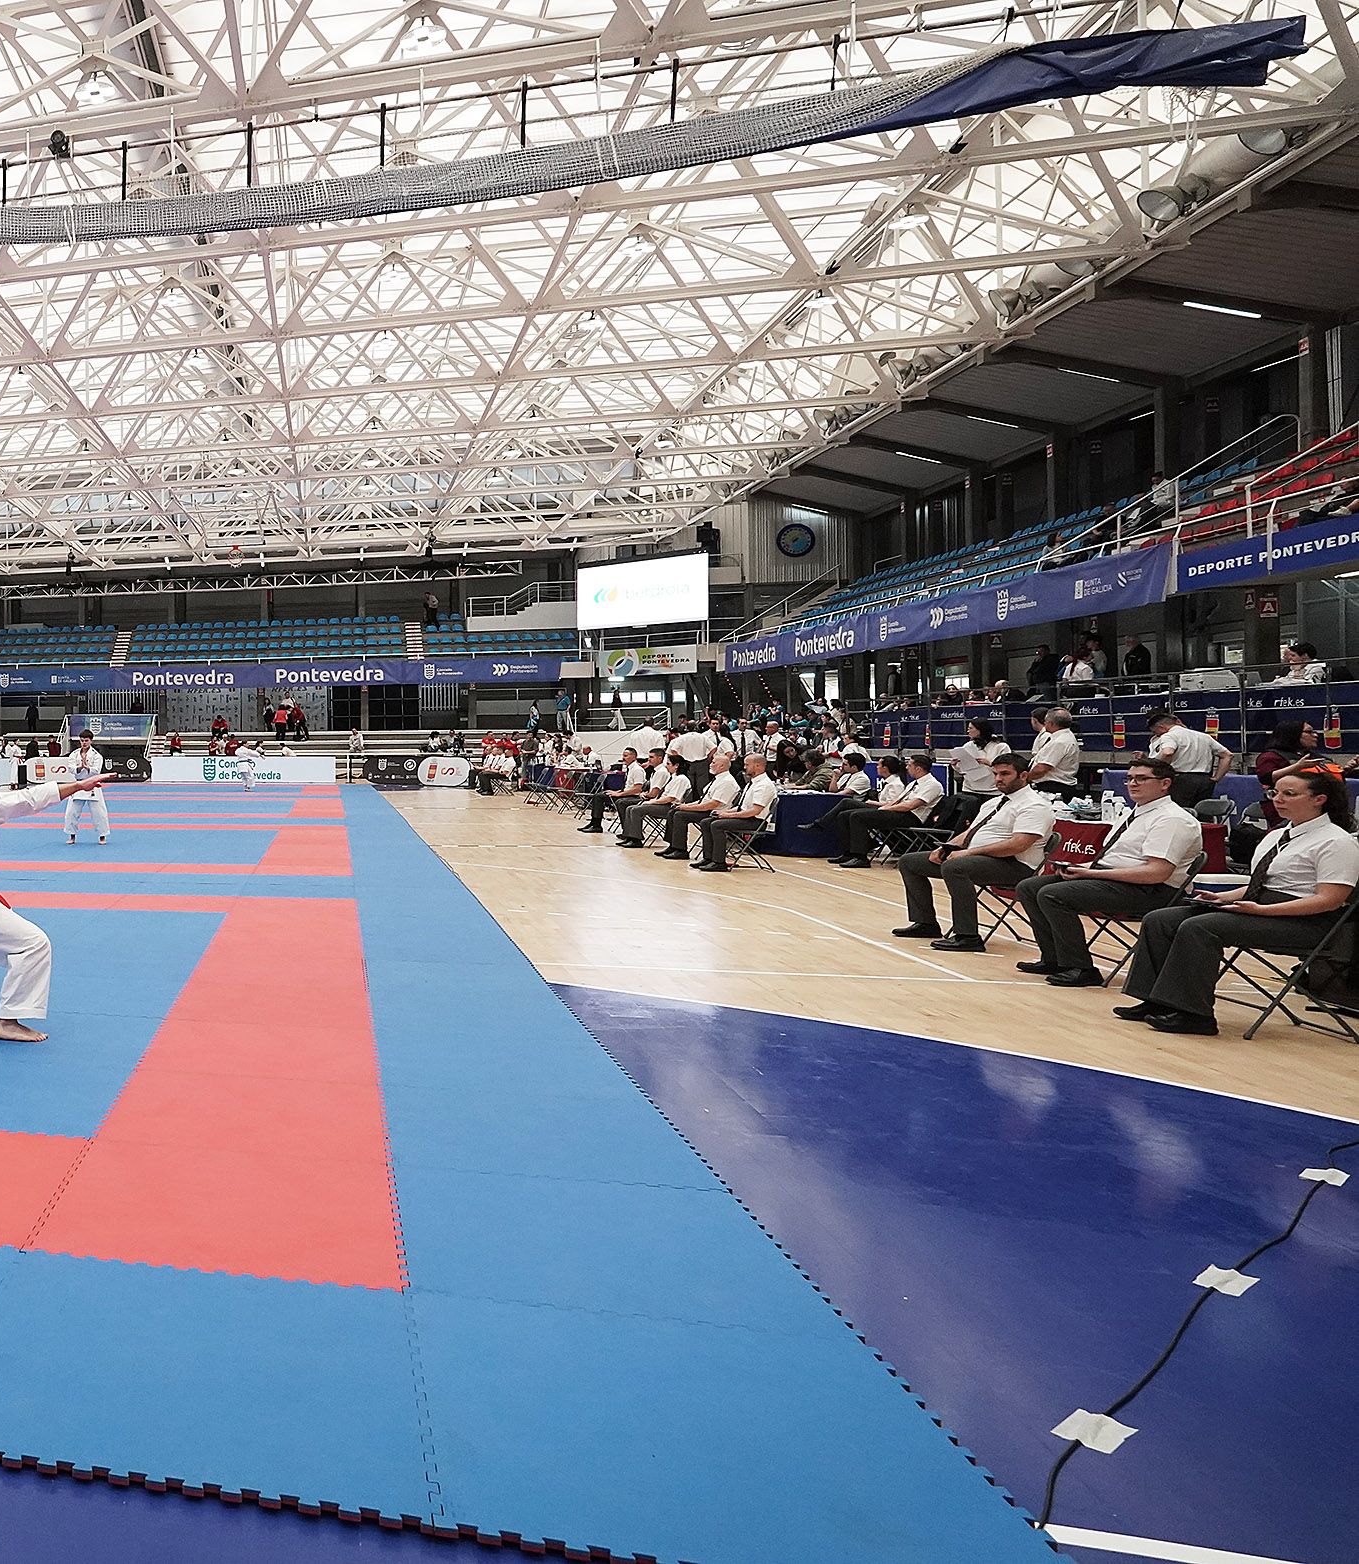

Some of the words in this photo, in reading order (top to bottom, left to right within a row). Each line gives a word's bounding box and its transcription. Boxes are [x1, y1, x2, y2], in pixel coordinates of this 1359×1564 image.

[1188, 554, 1253, 577] DEPORTE
[1083, 577, 1102, 588] XUNTA
[1083, 588, 1091, 597] DE
[1091, 584, 1113, 596] GALICIA
[1262, 602, 1275, 612] A
[795, 626, 855, 658] Pontevedra
[732, 642, 777, 668] Pontevedra
[132, 669, 234, 686] Pontevedra
[275, 665, 384, 684] Pontevedra
[1273, 697, 1305, 707] rfek.es
[218, 771, 230, 779] de
[232, 770, 282, 780] Povedra
[1062, 838, 1096, 855] rfek.es
